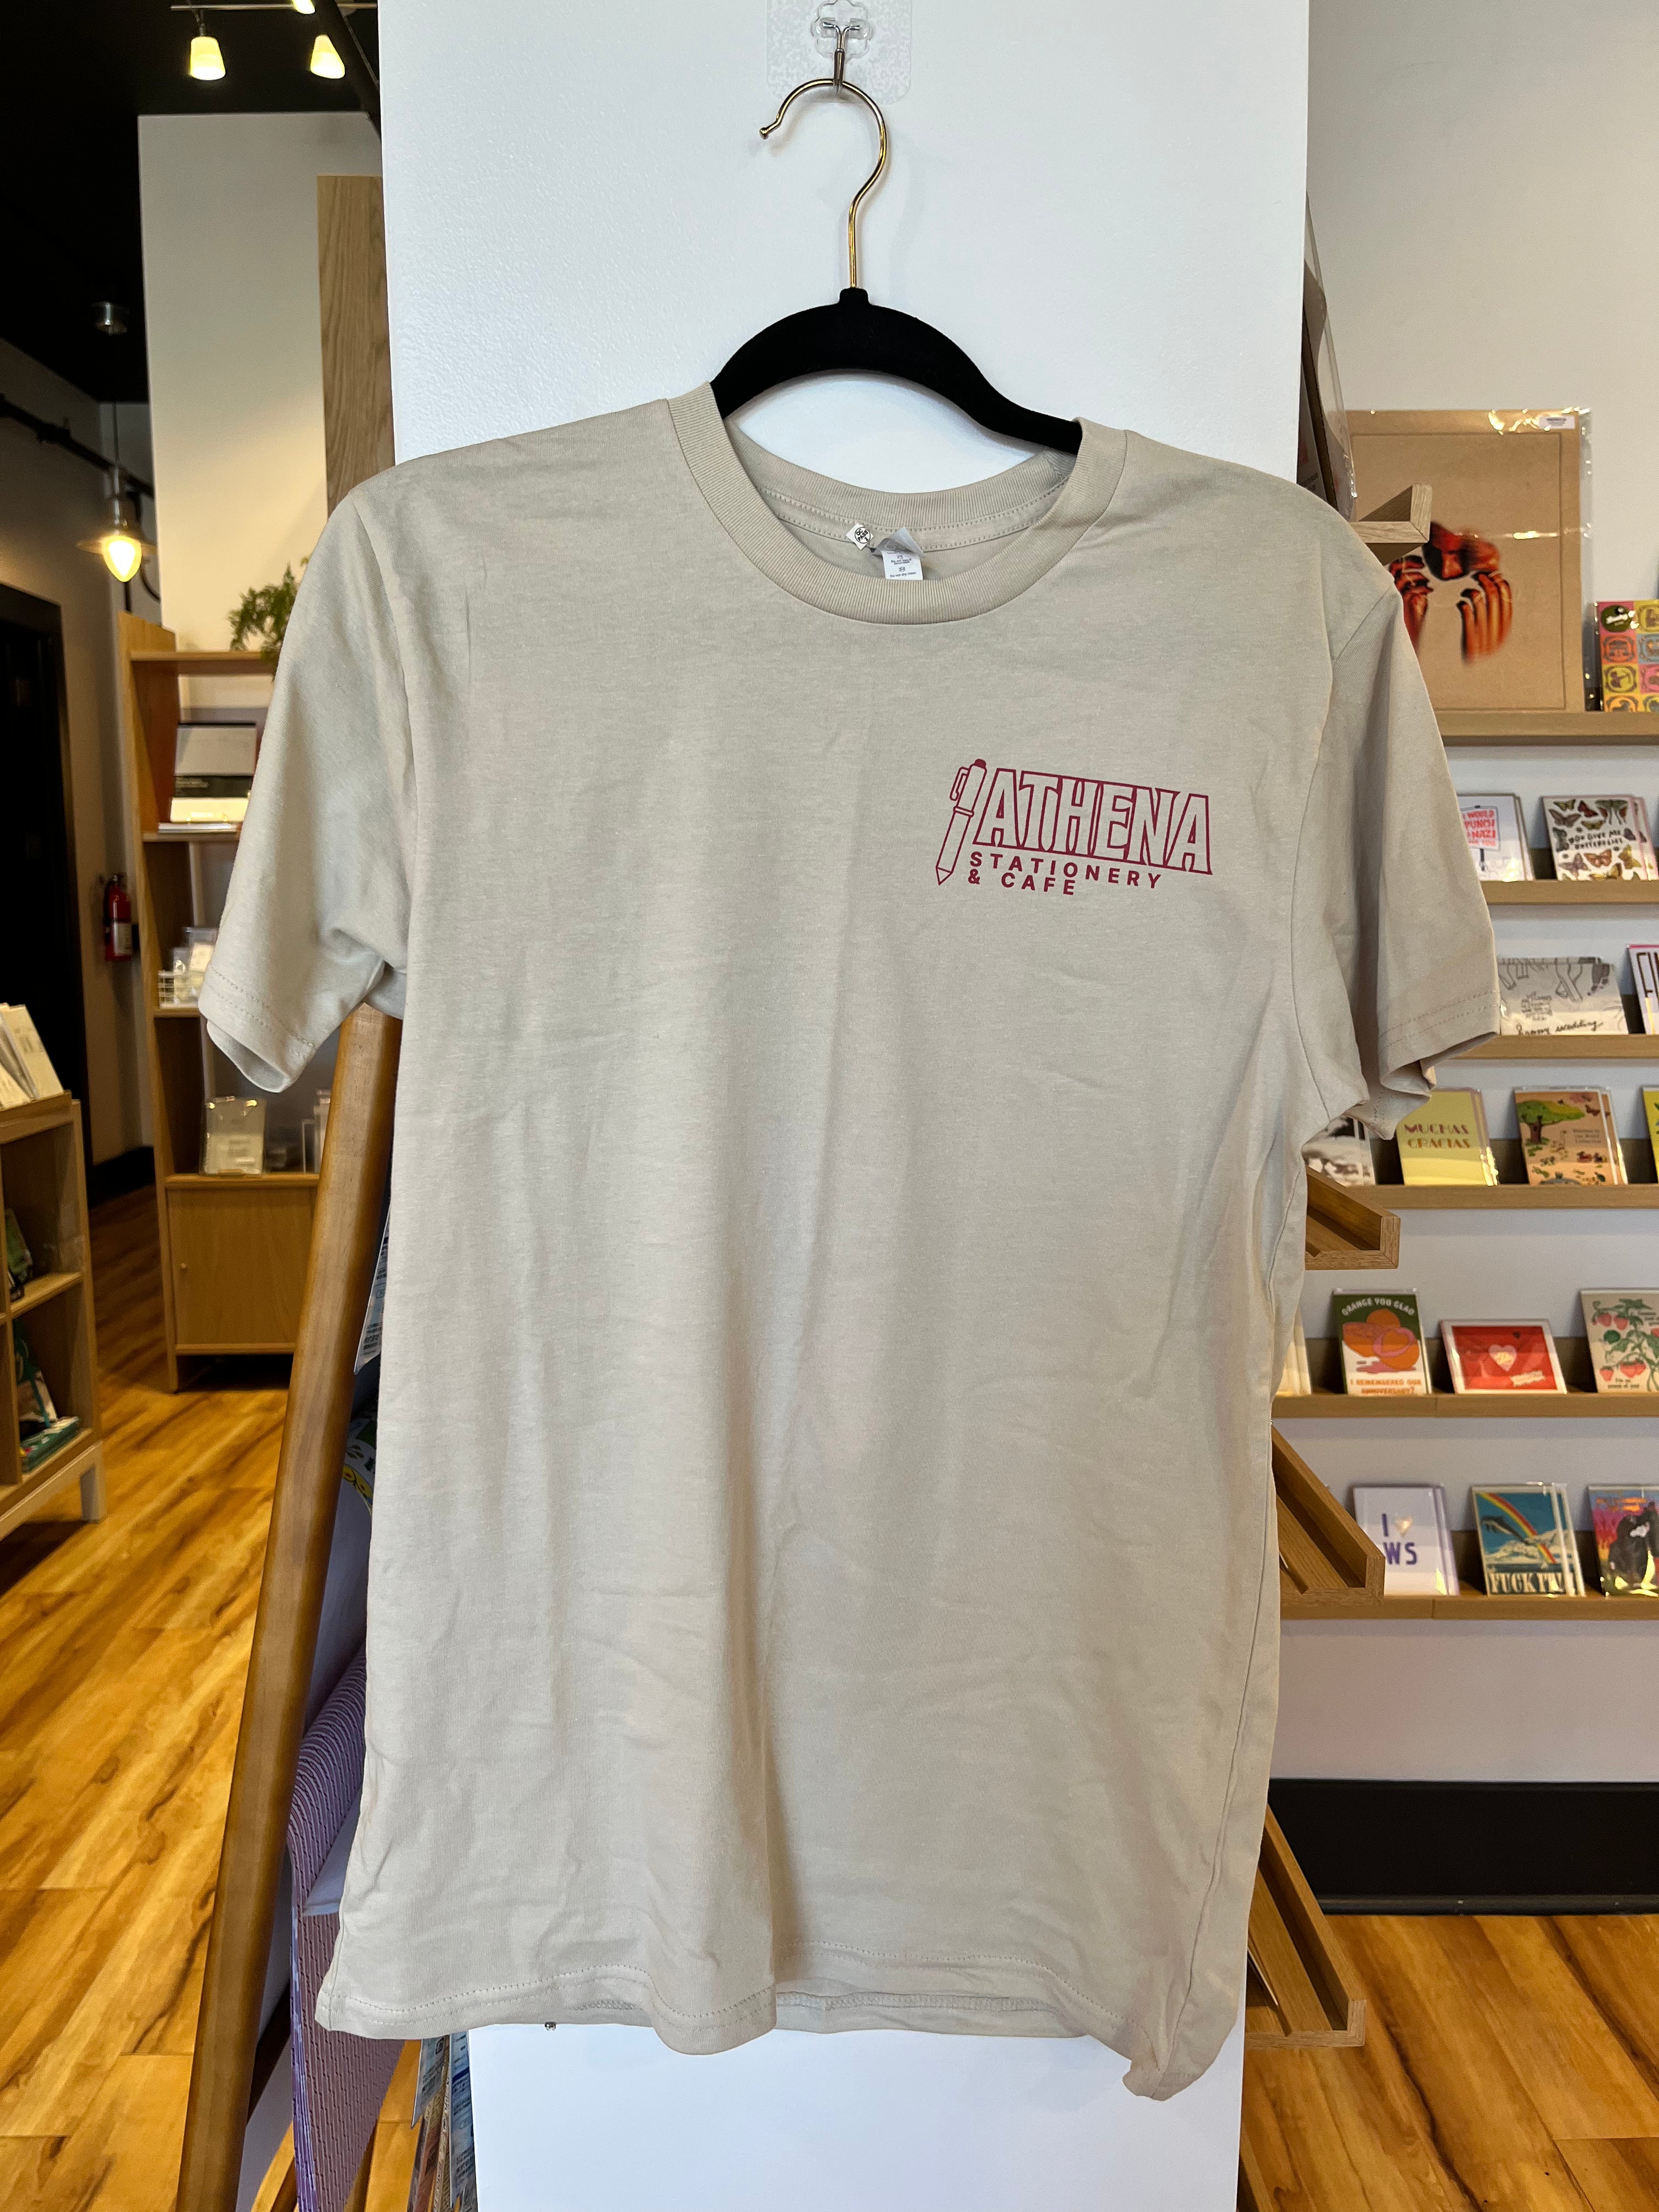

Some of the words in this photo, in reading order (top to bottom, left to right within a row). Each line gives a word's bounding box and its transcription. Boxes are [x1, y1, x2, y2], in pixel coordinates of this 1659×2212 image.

[857, 530, 868, 541] PASS
[972, 768, 1213, 876] ATHENA
[1463, 819, 1495, 830] PUNCH
[969, 851, 1161, 889] STATIONERY
[968, 868, 981, 885] &
[1001, 872, 1075, 895] CAFE
[1404, 1124, 1469, 1135] MUCHAS
[1407, 1137, 1471, 1149] GRACIAS
[1341, 1297, 1373, 1317] ORANGE
[1374, 1297, 1392, 1306] YOU
[1393, 1300, 1415, 1316] GLAD
[1382, 1513, 1389, 1537] I
[1383, 1542, 1418, 1565] WS
[1489, 1572, 1536, 1593] FUCK
